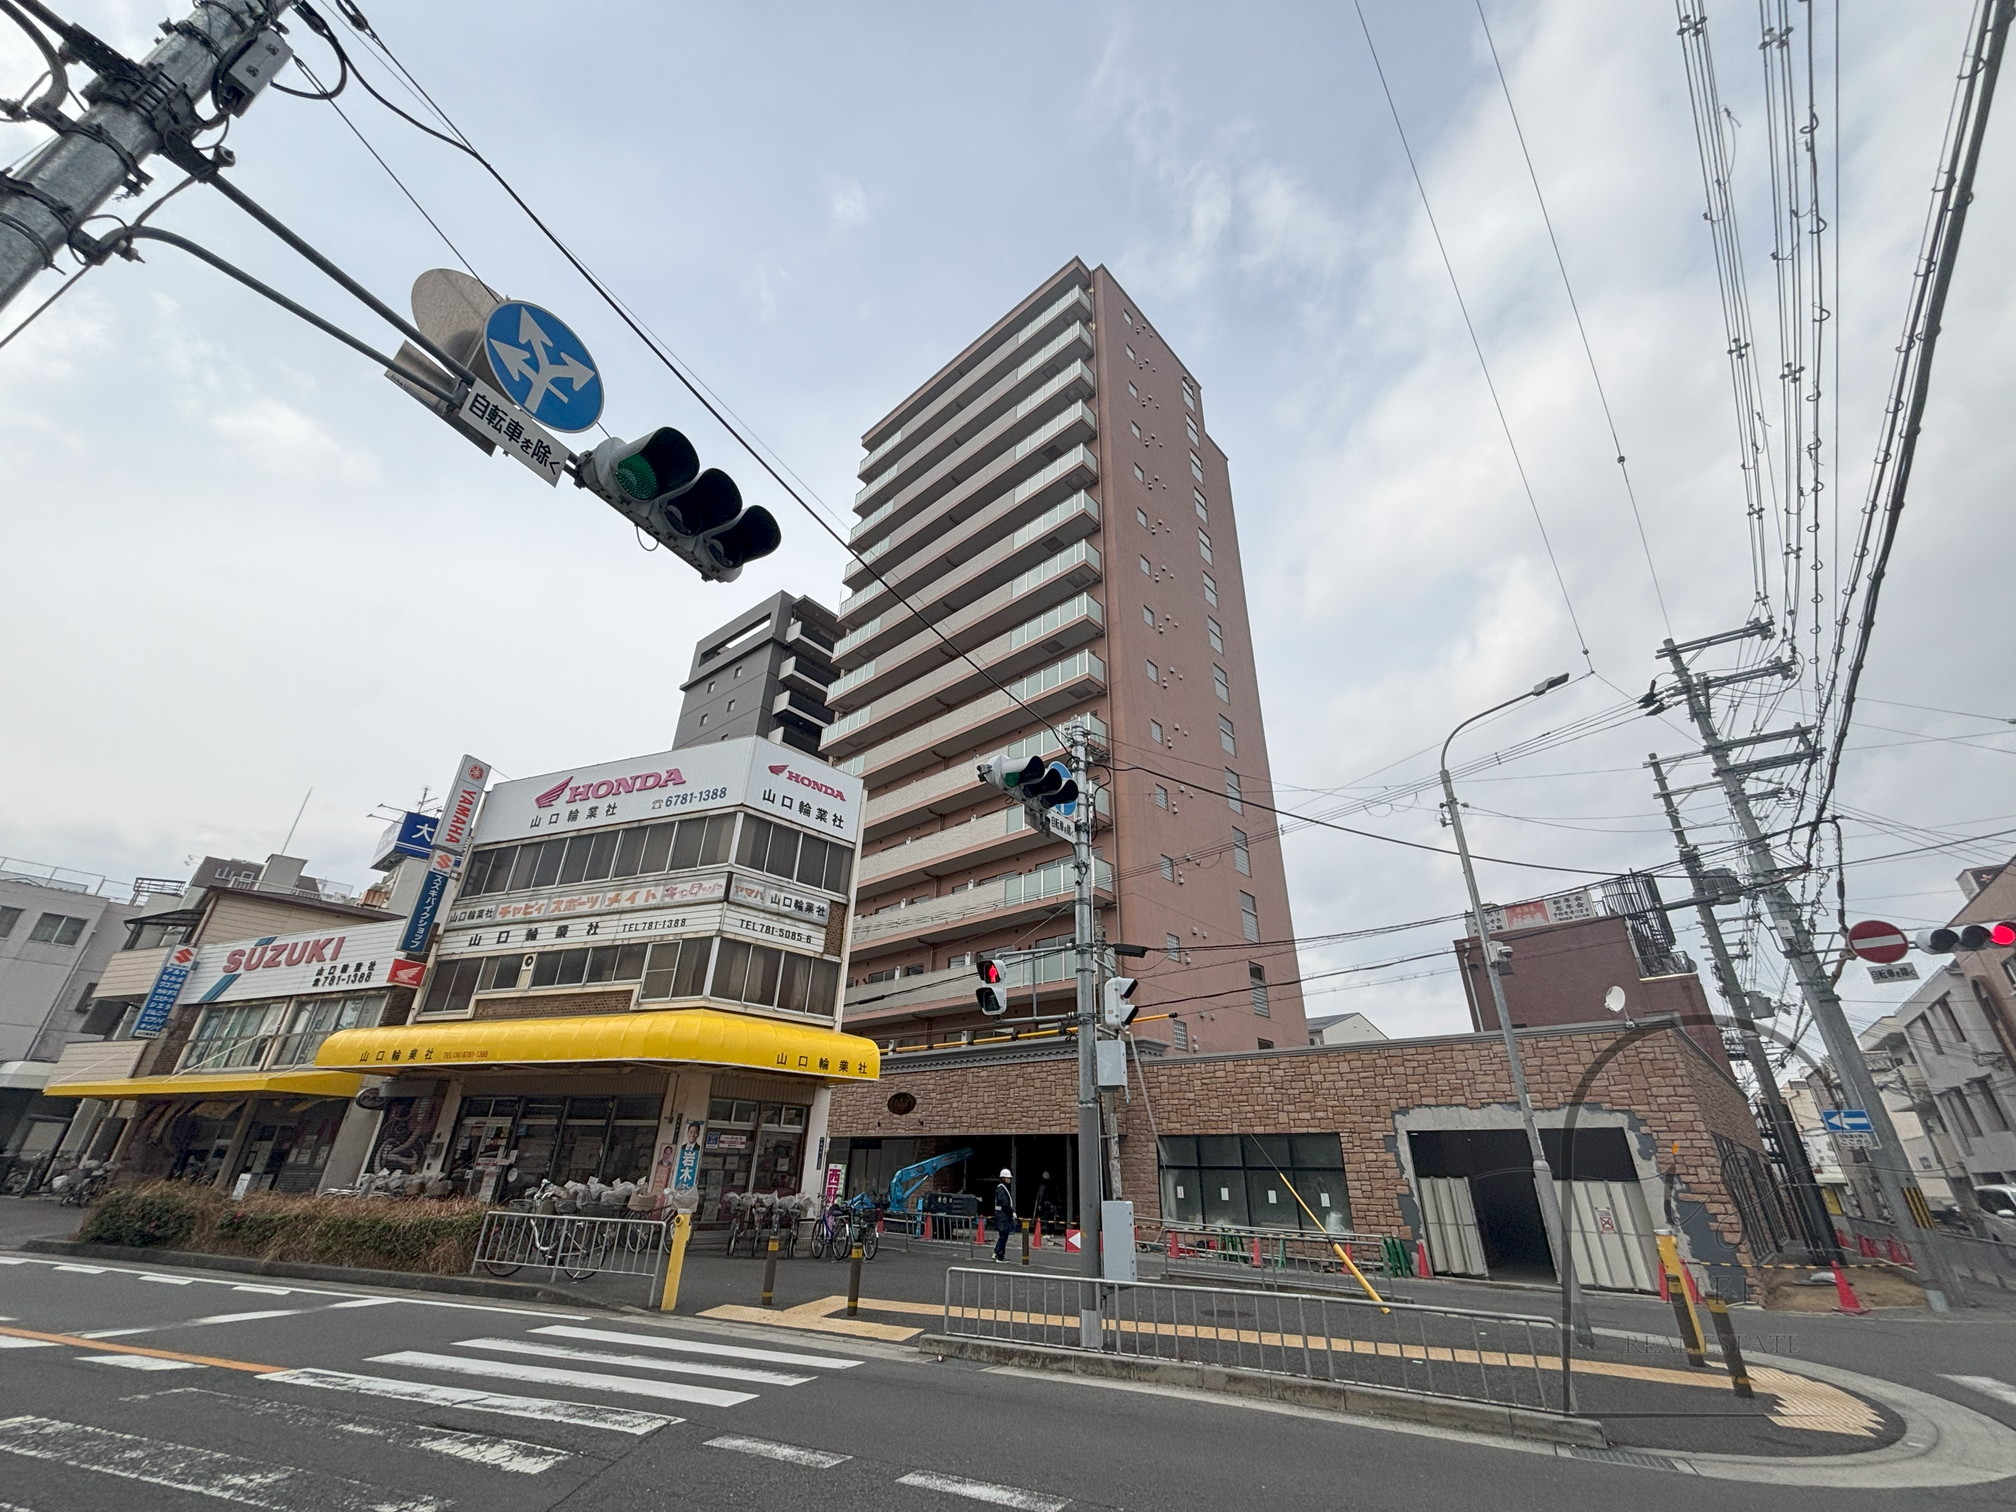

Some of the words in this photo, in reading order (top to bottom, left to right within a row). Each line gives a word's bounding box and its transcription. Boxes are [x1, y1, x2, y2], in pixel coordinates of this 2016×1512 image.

[469, 393, 560, 475] 自転車を除く
[566, 768, 686, 804] HONDA
[665, 787, 727, 808] 6781-1388
[786, 770, 846, 802] HONDA
[445, 789, 477, 844] YAMAHA
[529, 803, 618, 829] 山口輪業社
[762, 788, 844, 829] 山口輪業社
[410, 874, 442, 949] スズキバイクショップ
[450, 907, 494, 923] 山口輪業社
[468, 921, 600, 947] 山口輪業社
[222, 936, 346, 974] SUZUKI
[321, 971, 373, 987] 781-1388
[359, 1047, 434, 1062] 山口輪業社
[776, 1051, 867, 1075] 山口輪業社
